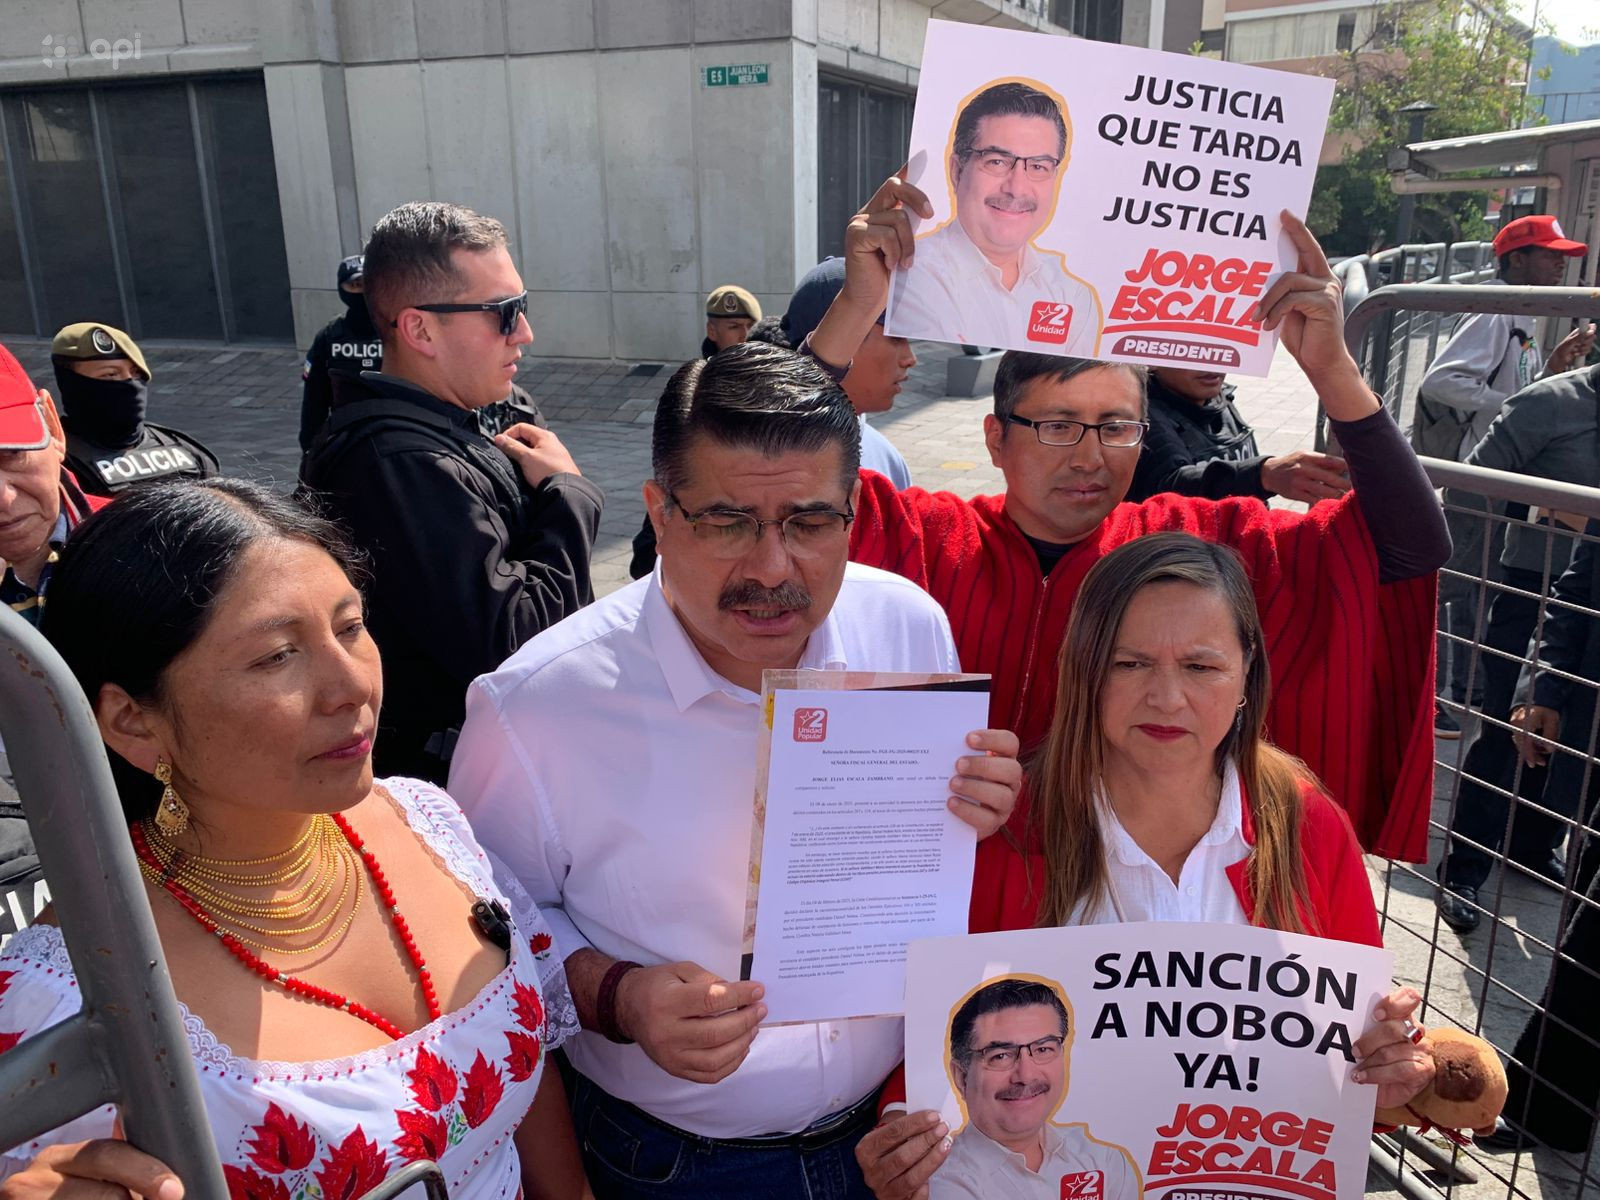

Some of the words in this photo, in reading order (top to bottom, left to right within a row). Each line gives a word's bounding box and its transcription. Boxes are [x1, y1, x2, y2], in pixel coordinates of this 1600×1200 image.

[730, 66, 748, 76] JUAN
[1124, 75, 1284, 124] JUSTICIA
[1098, 114, 1181, 149] QUE
[1189, 125, 1302, 167] TARDA
[1142, 160, 1201, 191] NO
[1210, 170, 1251, 198] ES
[1103, 197, 1267, 240] JUSTICIA
[1125, 248, 1274, 297] JORGE
[1048, 304, 1069, 326] 2
[1108, 285, 1263, 331] ESCALA
[1032, 324, 1065, 335] Unidad
[332, 343, 382, 357] POLICI
[1123, 339, 1234, 363] PRESIDENTE
[96, 448, 194, 481] POLICIA
[797, 733, 822, 741] Popular
[798, 727, 823, 735] Unidad
[809, 710, 826, 728] 2
[1092, 951, 1358, 1011] SANCIÓN
[1091, 1002, 1128, 1039] A
[1145, 1001, 1357, 1063] NOBOA
[1174, 1052, 1260, 1092] YA!
[1156, 1103, 1335, 1155] JORGE
[1080, 1171, 1099, 1194] 2
[1147, 1141, 1336, 1192] ESCALA
